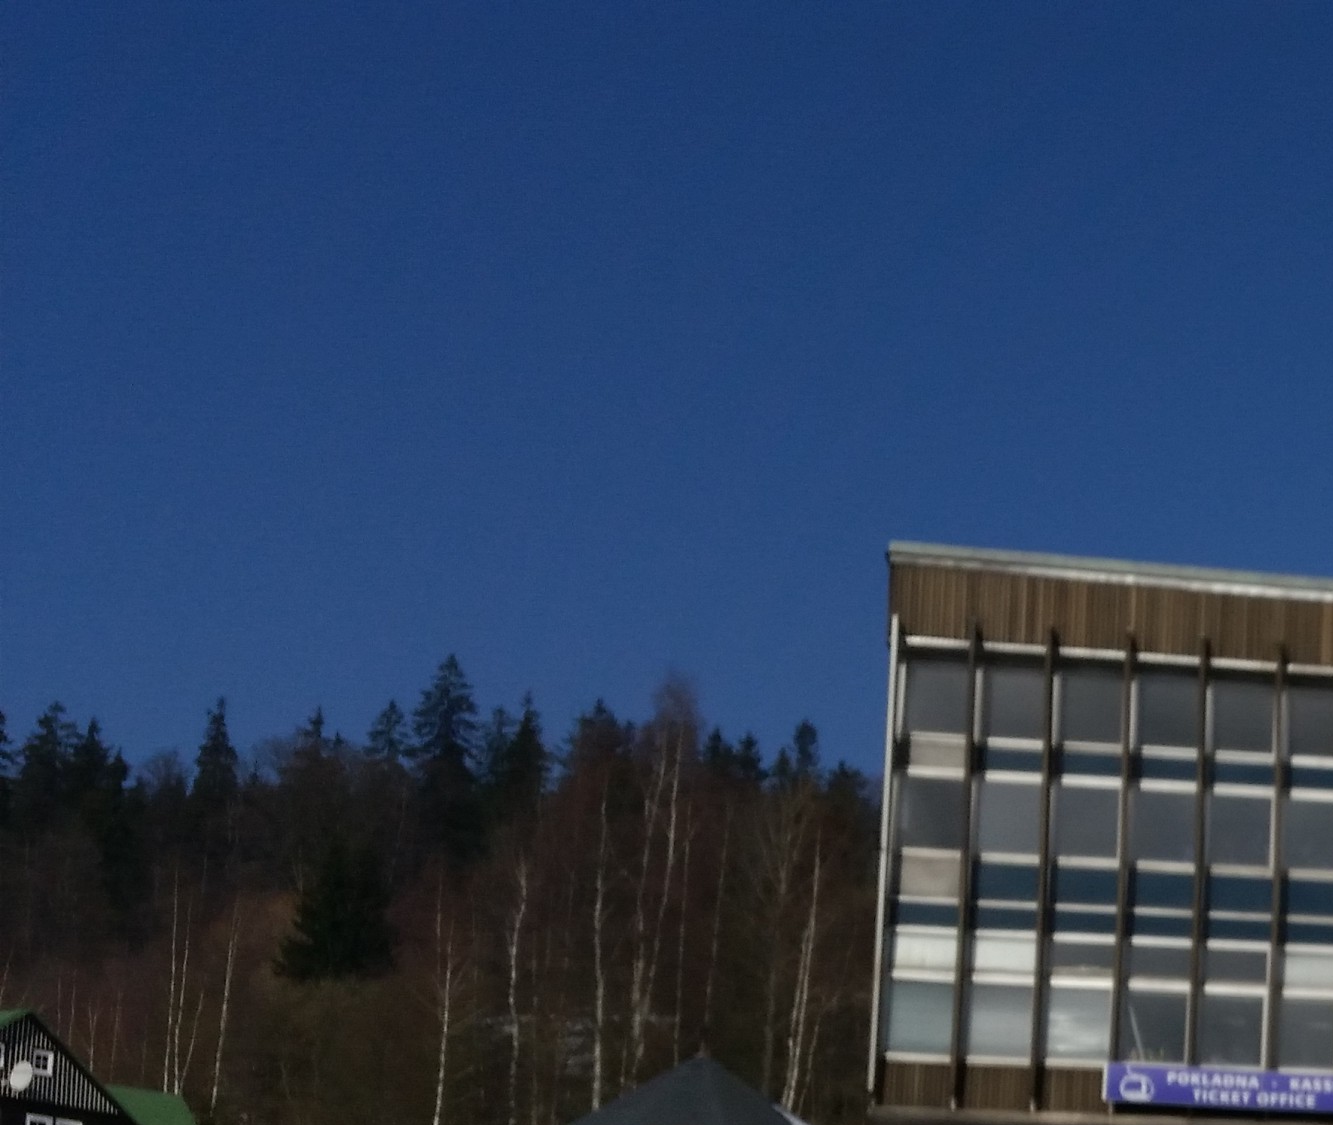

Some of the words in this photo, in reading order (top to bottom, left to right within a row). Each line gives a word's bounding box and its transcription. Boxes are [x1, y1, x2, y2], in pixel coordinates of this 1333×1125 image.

[1166, 1070, 1260, 1090] POKLADNA
[1192, 1089, 1251, 1107] TICKET
[1256, 1091, 1317, 1110] OFFICE
